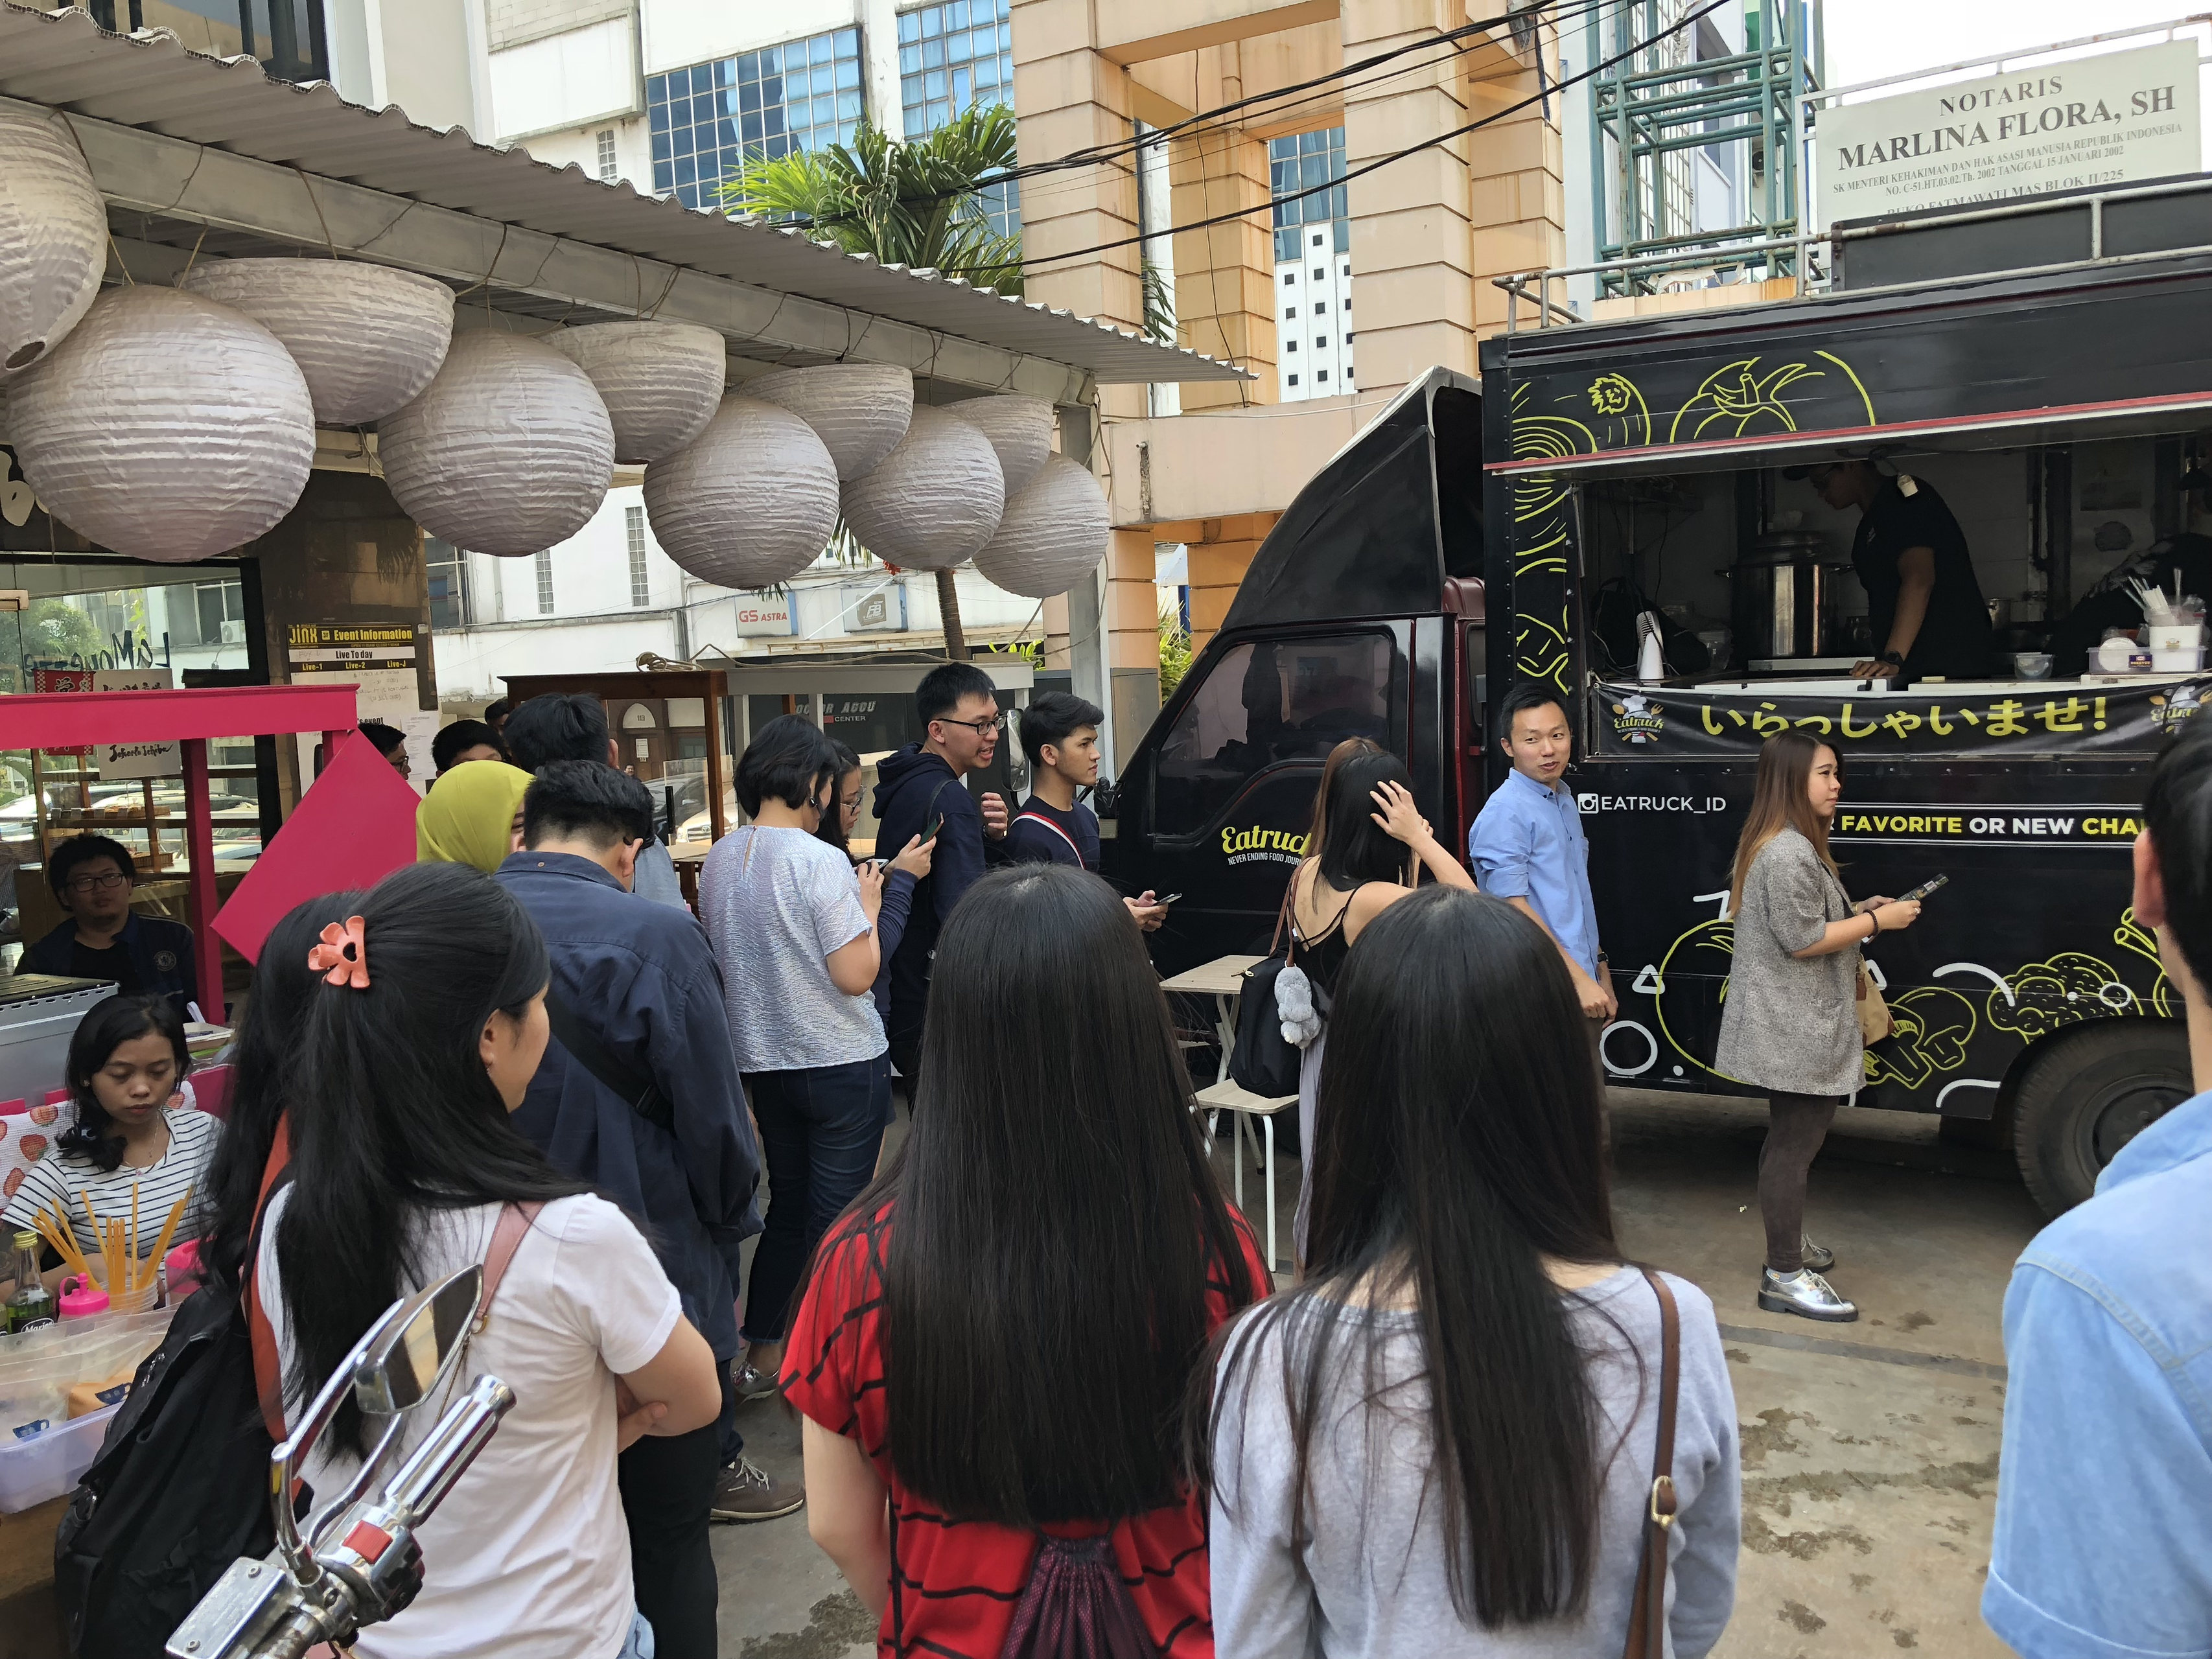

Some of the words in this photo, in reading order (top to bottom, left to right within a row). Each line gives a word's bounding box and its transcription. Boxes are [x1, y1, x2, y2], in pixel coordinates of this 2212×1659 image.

[1938, 75, 2063, 117] NOTARIS
[1837, 121, 1990, 171] MARLINA
[1996, 98, 2121, 141] FLORA,
[2130, 85, 2176, 117] SH
[1833, 183, 1845, 194] SK
[1847, 175, 1889, 191] MENTERI
[1891, 163, 1950, 183] KEHAKIMAN
[1951, 159, 1972, 172] DAN
[1973, 155, 1995, 168] HAK
[1996, 150, 2024, 163] ASASI
[2026, 142, 2072, 158] MANUSIA
[2073, 132, 2125, 150] REPUBLIK
[2126, 123, 2182, 141] INDONESIA
[1885, 185, 1902, 196] NO.
[1977, 167, 1996, 180] 2002
[1997, 158, 2045, 176] TANGGAL
[2047, 157, 2056, 167] 15
[2058, 149, 2102, 165] JANUARI
[2104, 145, 2124, 158] 2002
[2012, 182, 2042, 197] MAS
[2045, 175, 2084, 192] BLOK
[739, 609, 759, 623] GS
[761, 612, 787, 622] ASTRA
[334, 629, 360, 641] Event
[360, 629, 413, 640] Information
[335, 650, 350, 659] Live
[1613, 716, 1664, 729] Eatruck
[1701, 696, 2106, 739] いらっしゃいませ!
[1601, 796, 1727, 814] EATRUCK_ID
[1841, 815, 1962, 835] FAVORITE
[1968, 817, 2005, 835] OR
[2012, 817, 2075, 835] NEW
[1228, 853, 1247, 866] NEVER
[1247, 852, 1268, 861] ENDING
[1269, 852, 1284, 862] FOOD
